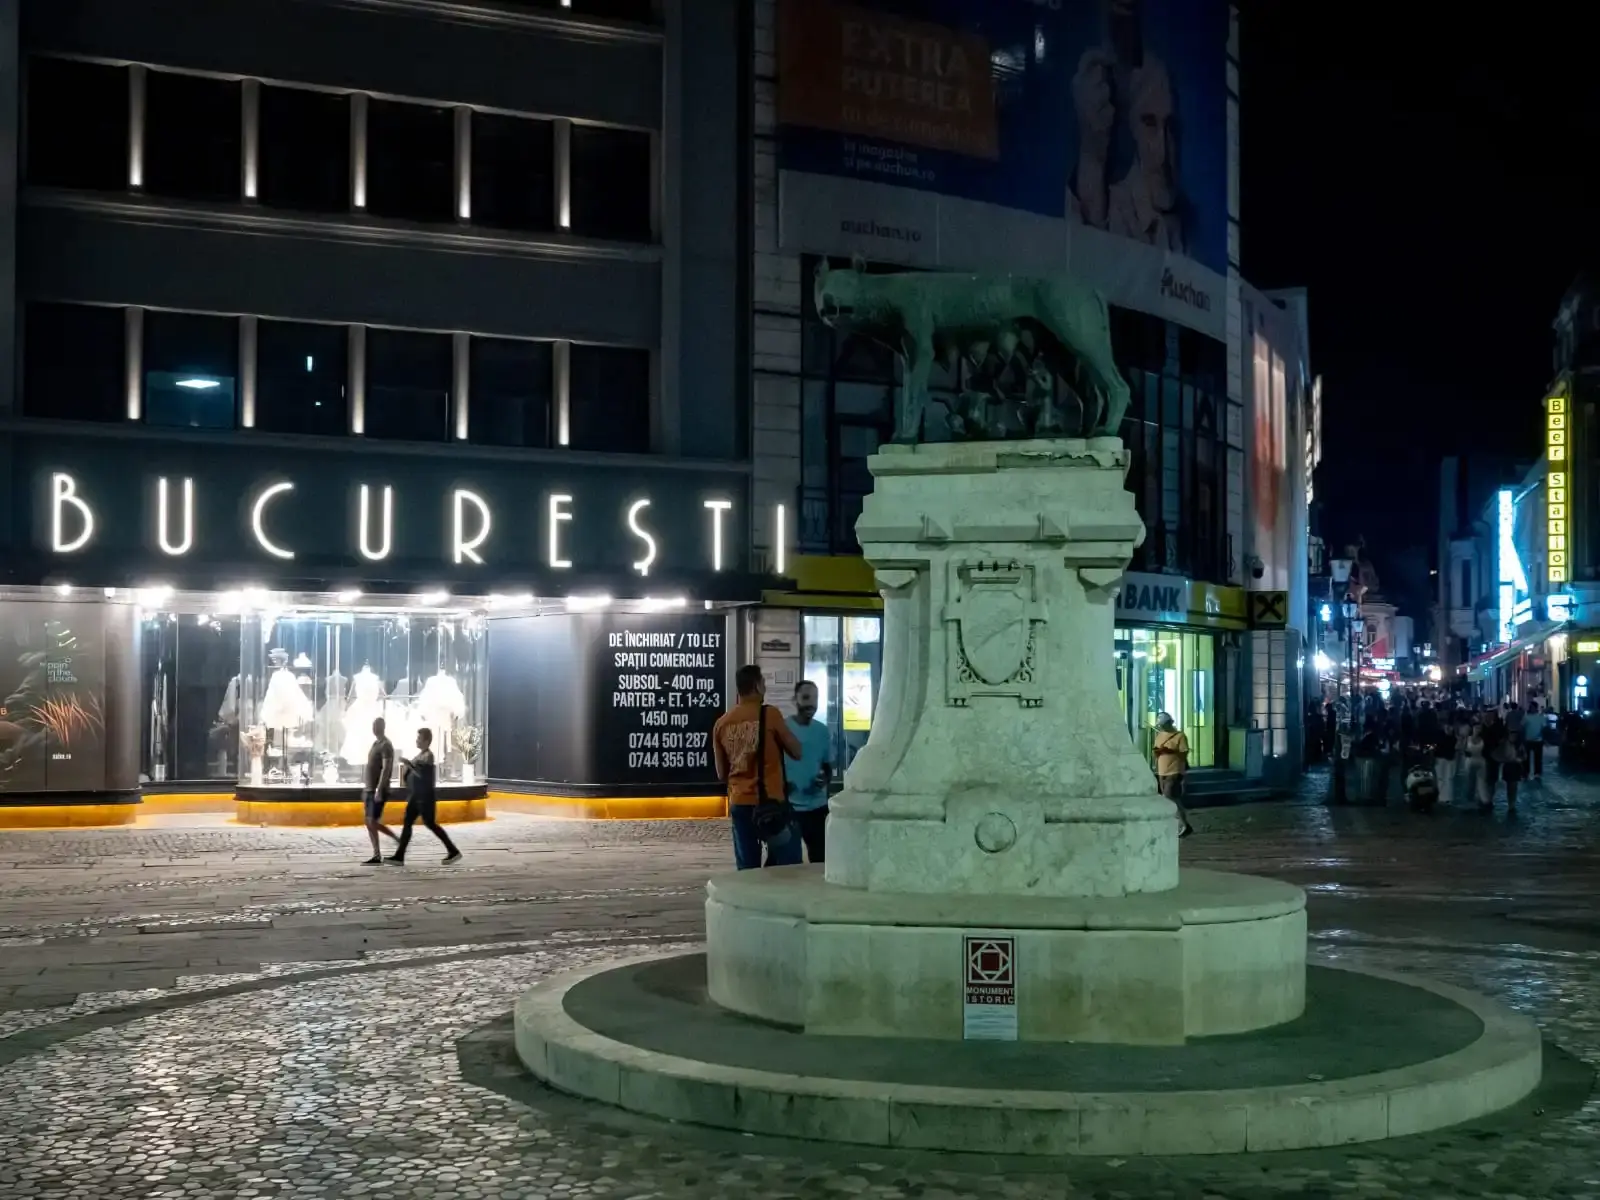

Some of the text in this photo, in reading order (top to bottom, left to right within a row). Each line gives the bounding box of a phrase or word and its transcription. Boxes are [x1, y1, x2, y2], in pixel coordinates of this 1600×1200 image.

[841, 218, 921, 242] auchan.ro
[1160, 268, 1210, 312] Auchan
[1551, 399, 1563, 460] Beer
[51, 472, 787, 577] BUCUREȘTI
[1551, 474, 1563, 580] Station
[1125, 584, 1181, 612] BANK
[609, 632, 623, 647] DE
[624, 629, 676, 648] ÎNCHIRIAT
[687, 633, 700, 647] TO
[702, 633, 721, 648] LET
[649, 653, 715, 668] COMERCIALE
[618, 674, 662, 690] SUBSOL
[671, 675, 694, 690] 400
[696, 677, 714, 692] mp
[613, 692, 656, 707] PARTER
[668, 692, 684, 708] ET.
[686, 693, 720, 708] 1+2+3
[640, 711, 689, 728] 1450 mp
[628, 732, 708, 749] 0744 501 287
[628, 751, 708, 768] 0744 355 614
[966, 986, 1014, 995] MONUMENT
[966, 995, 1015, 1004] ISTORIC
